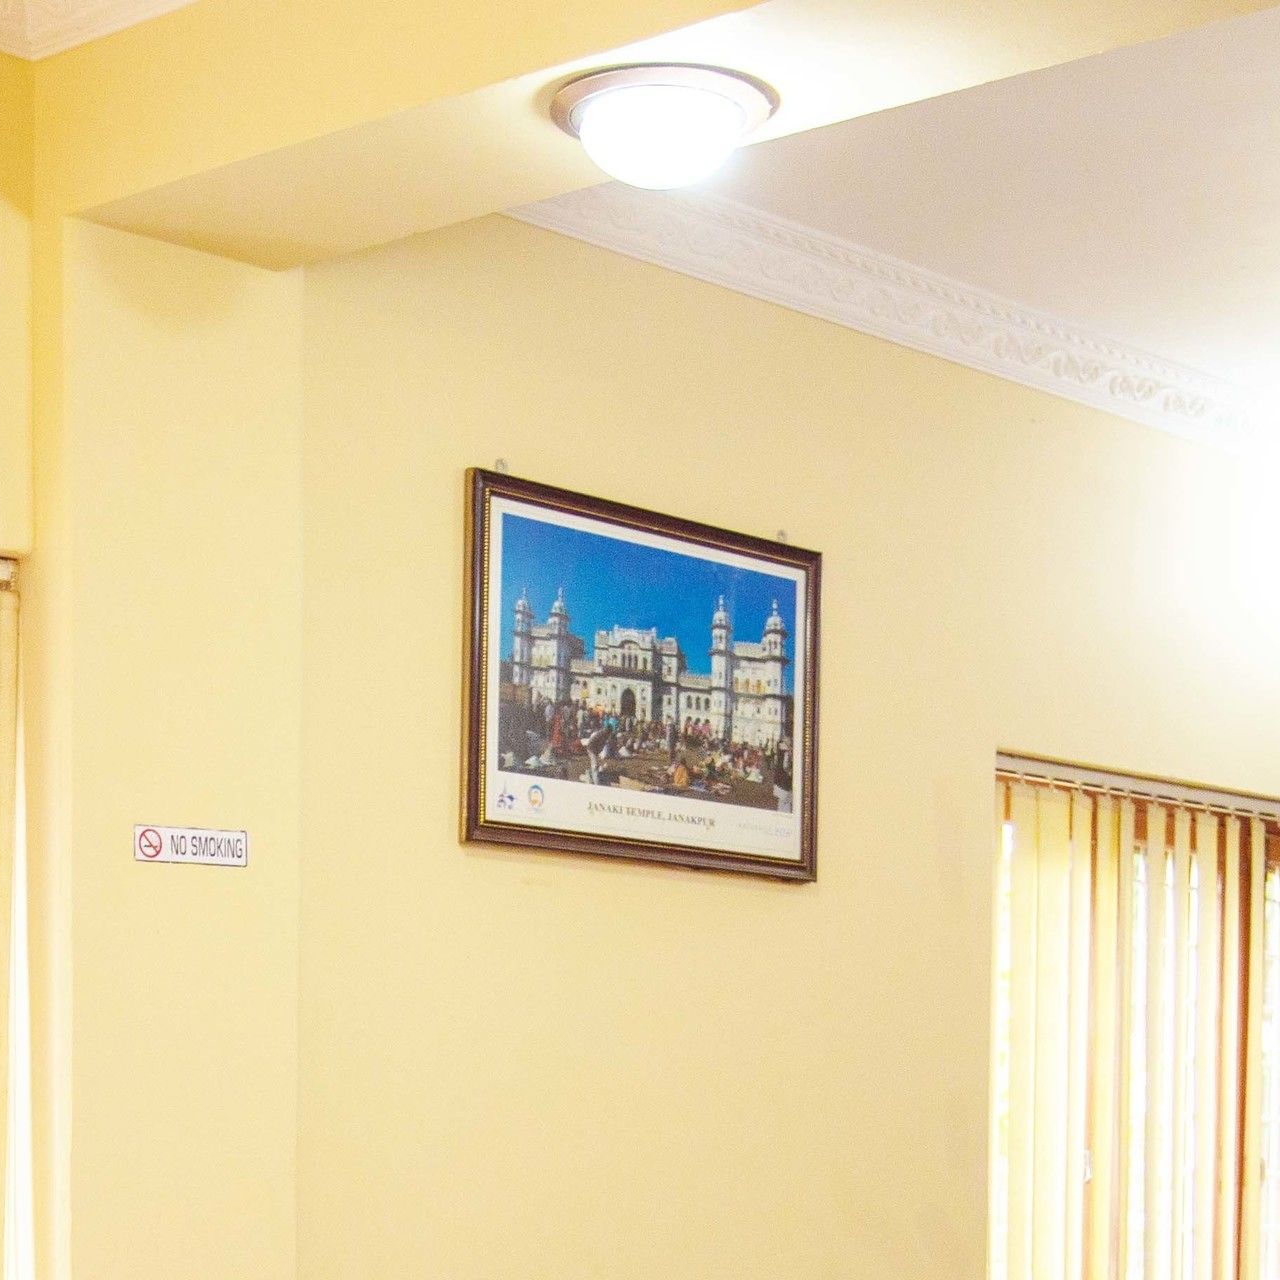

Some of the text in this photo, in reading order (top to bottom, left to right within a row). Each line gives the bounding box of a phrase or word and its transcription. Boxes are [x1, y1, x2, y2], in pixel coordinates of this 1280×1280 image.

[587, 801, 623, 815] JANAKI
[667, 812, 716, 827] JANAKPUR
[170, 834, 243, 858] NO SMOKING
